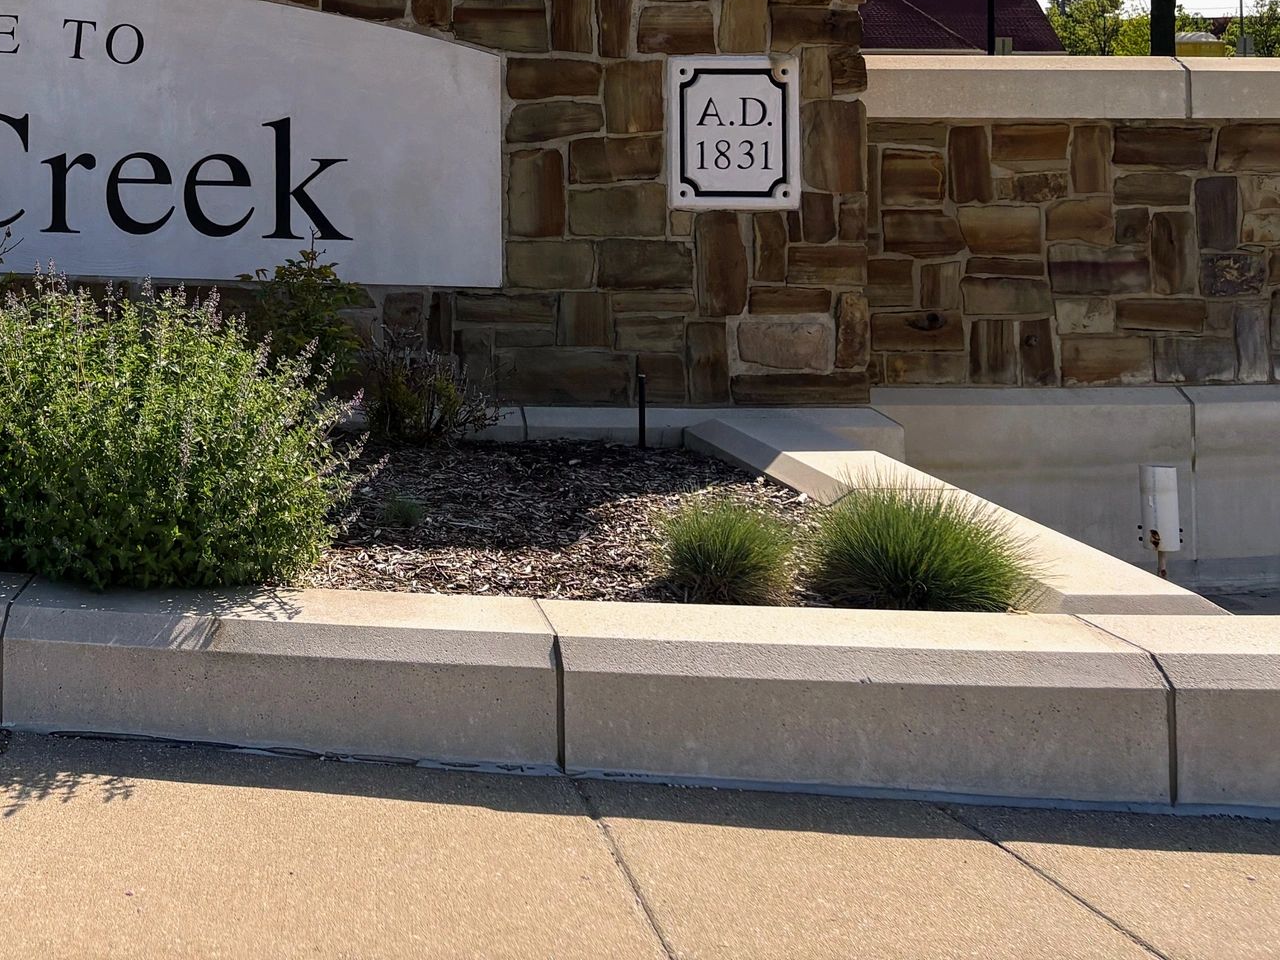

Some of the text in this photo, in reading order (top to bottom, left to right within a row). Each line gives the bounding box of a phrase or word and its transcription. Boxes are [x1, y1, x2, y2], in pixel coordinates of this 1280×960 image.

[63, 18, 144, 64] TO
[696, 96, 773, 127] A.D.
[696, 140, 773, 170] 1831
